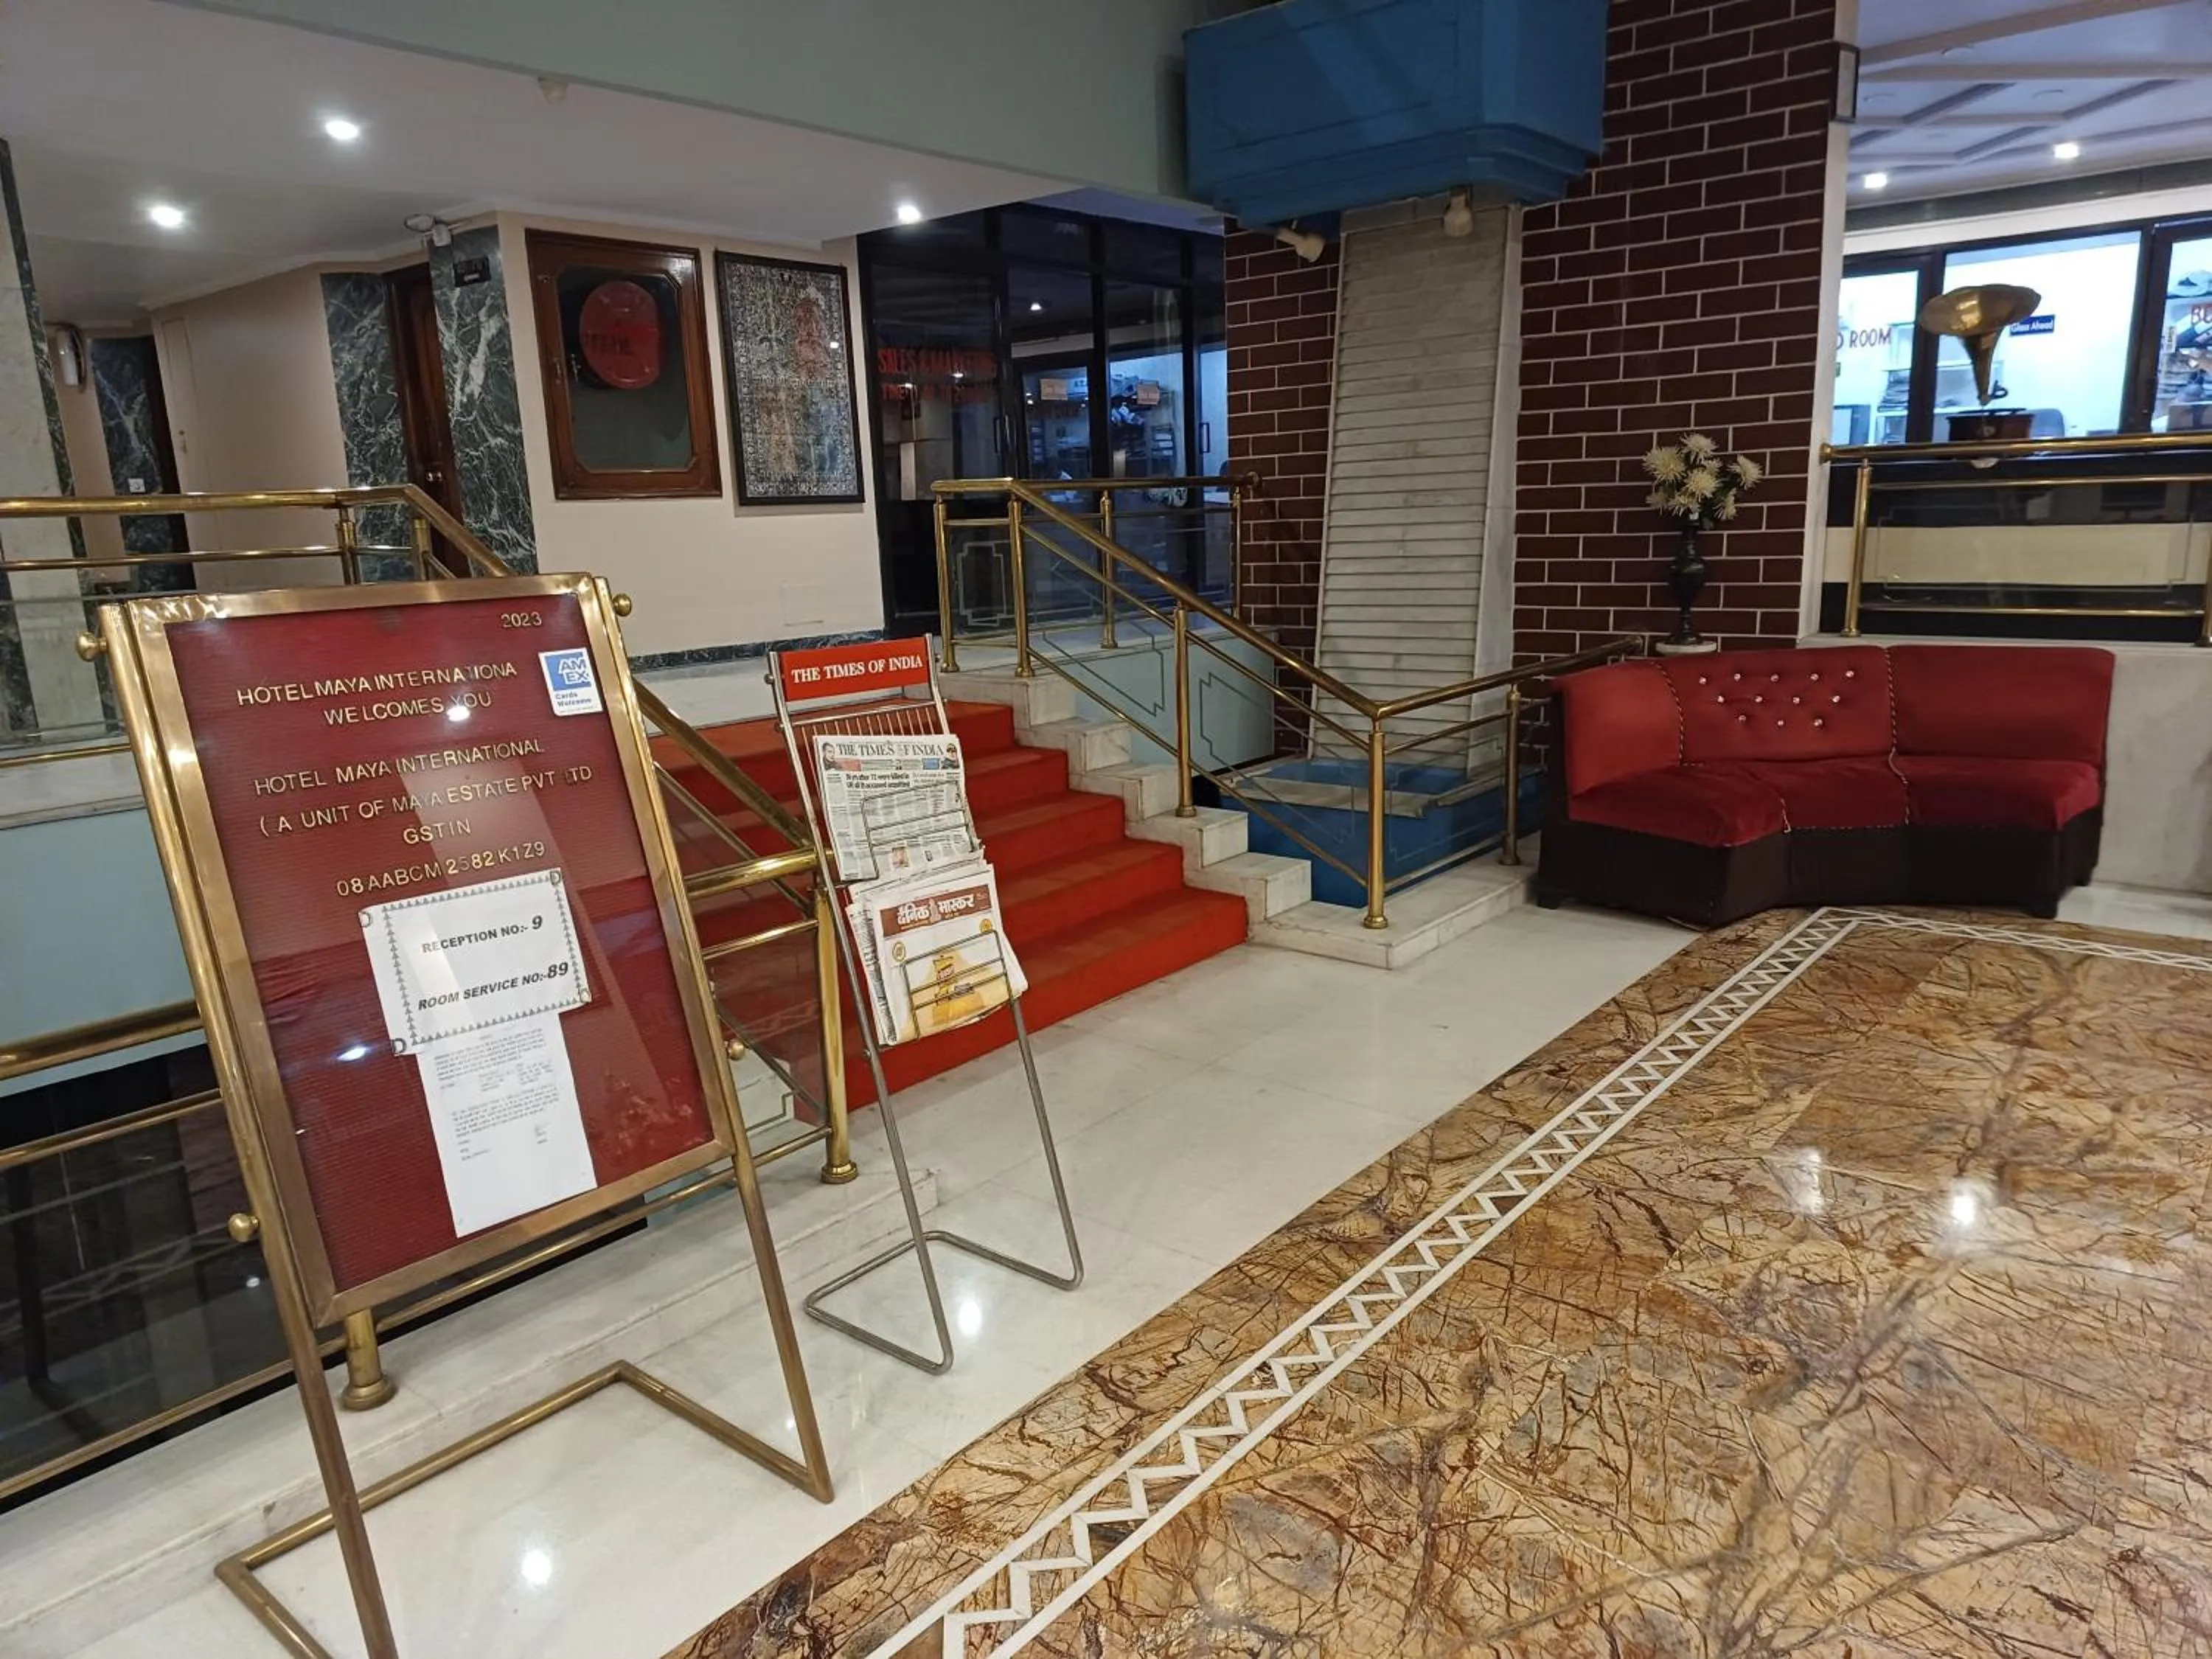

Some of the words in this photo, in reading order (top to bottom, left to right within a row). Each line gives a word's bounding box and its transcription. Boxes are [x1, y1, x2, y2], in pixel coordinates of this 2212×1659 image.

[1848, 327, 1892, 348] ROOM
[501, 611, 543, 627] 2023
[558, 657, 588, 674] AM
[563, 669, 589, 685] EX
[790, 667, 821, 684] THE
[823, 661, 866, 678] TIMES
[868, 659, 886, 673] OF
[888, 654, 923, 672] INDIA
[236, 684, 313, 706] HOTEL
[314, 676, 372, 697] MAYA
[451, 691, 492, 712] YOU
[835, 742, 857, 757] THE
[858, 742, 895, 757] TIMES
[911, 742, 945, 757] INDIA
[254, 771, 328, 796] HOTEL
[335, 760, 392, 783] MAYA
[394, 739, 545, 773] INTERNATIONAL
[277, 815, 293, 832] A
[300, 804, 350, 829] UNIT
[358, 799, 385, 818] OF
[448, 777, 518, 804] ESTATE
[521, 770, 555, 792] PVT
[403, 817, 472, 844] GSTIN
[421, 929, 498, 953] RECEPTION
[531, 914, 543, 931] 9
[417, 992, 460, 1011] ROOM
[463, 977, 519, 1000] SERVICE
